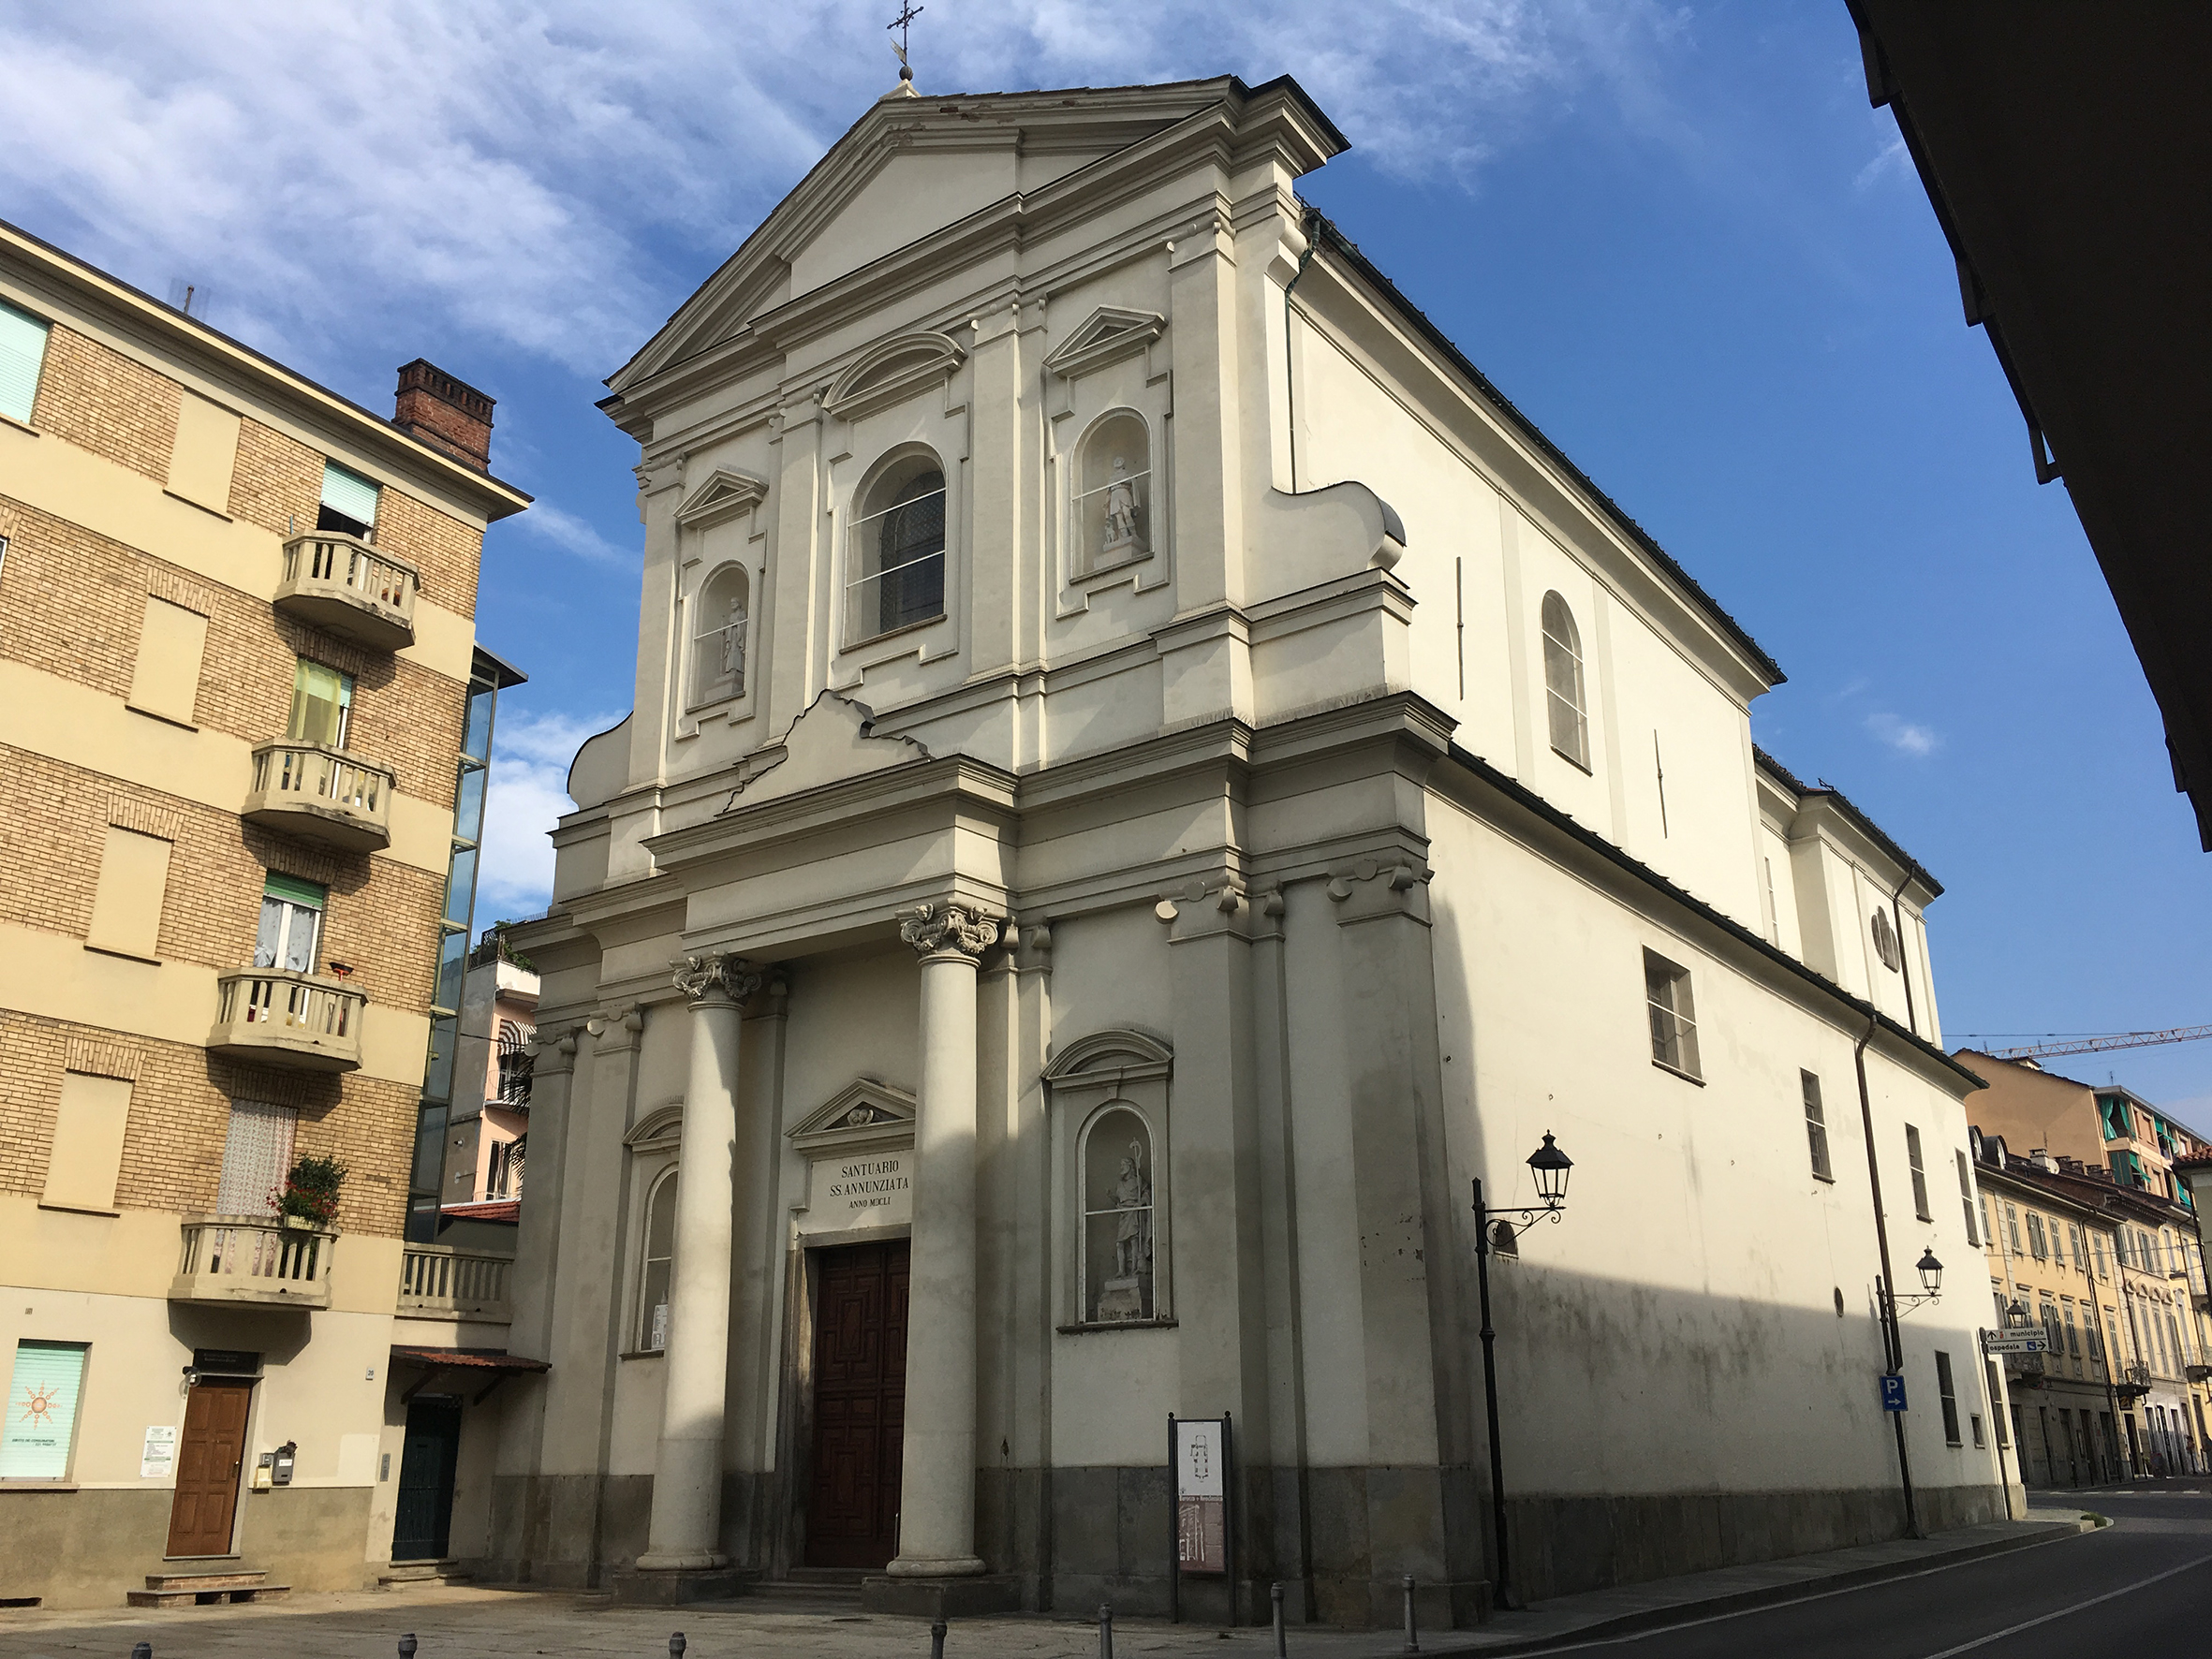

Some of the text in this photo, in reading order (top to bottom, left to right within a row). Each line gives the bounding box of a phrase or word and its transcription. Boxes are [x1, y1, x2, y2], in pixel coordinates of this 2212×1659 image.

[841, 1159, 899, 1179] SANTUARIO
[830, 1177, 909, 1197] SS. ANNUNZIATA
[848, 1197, 891, 1209] ANNO MDCLI
[2010, 1329, 2044, 1338] municipio
[1990, 1343, 2020, 1352] ospedale
[1886, 1379, 1898, 1394] P
